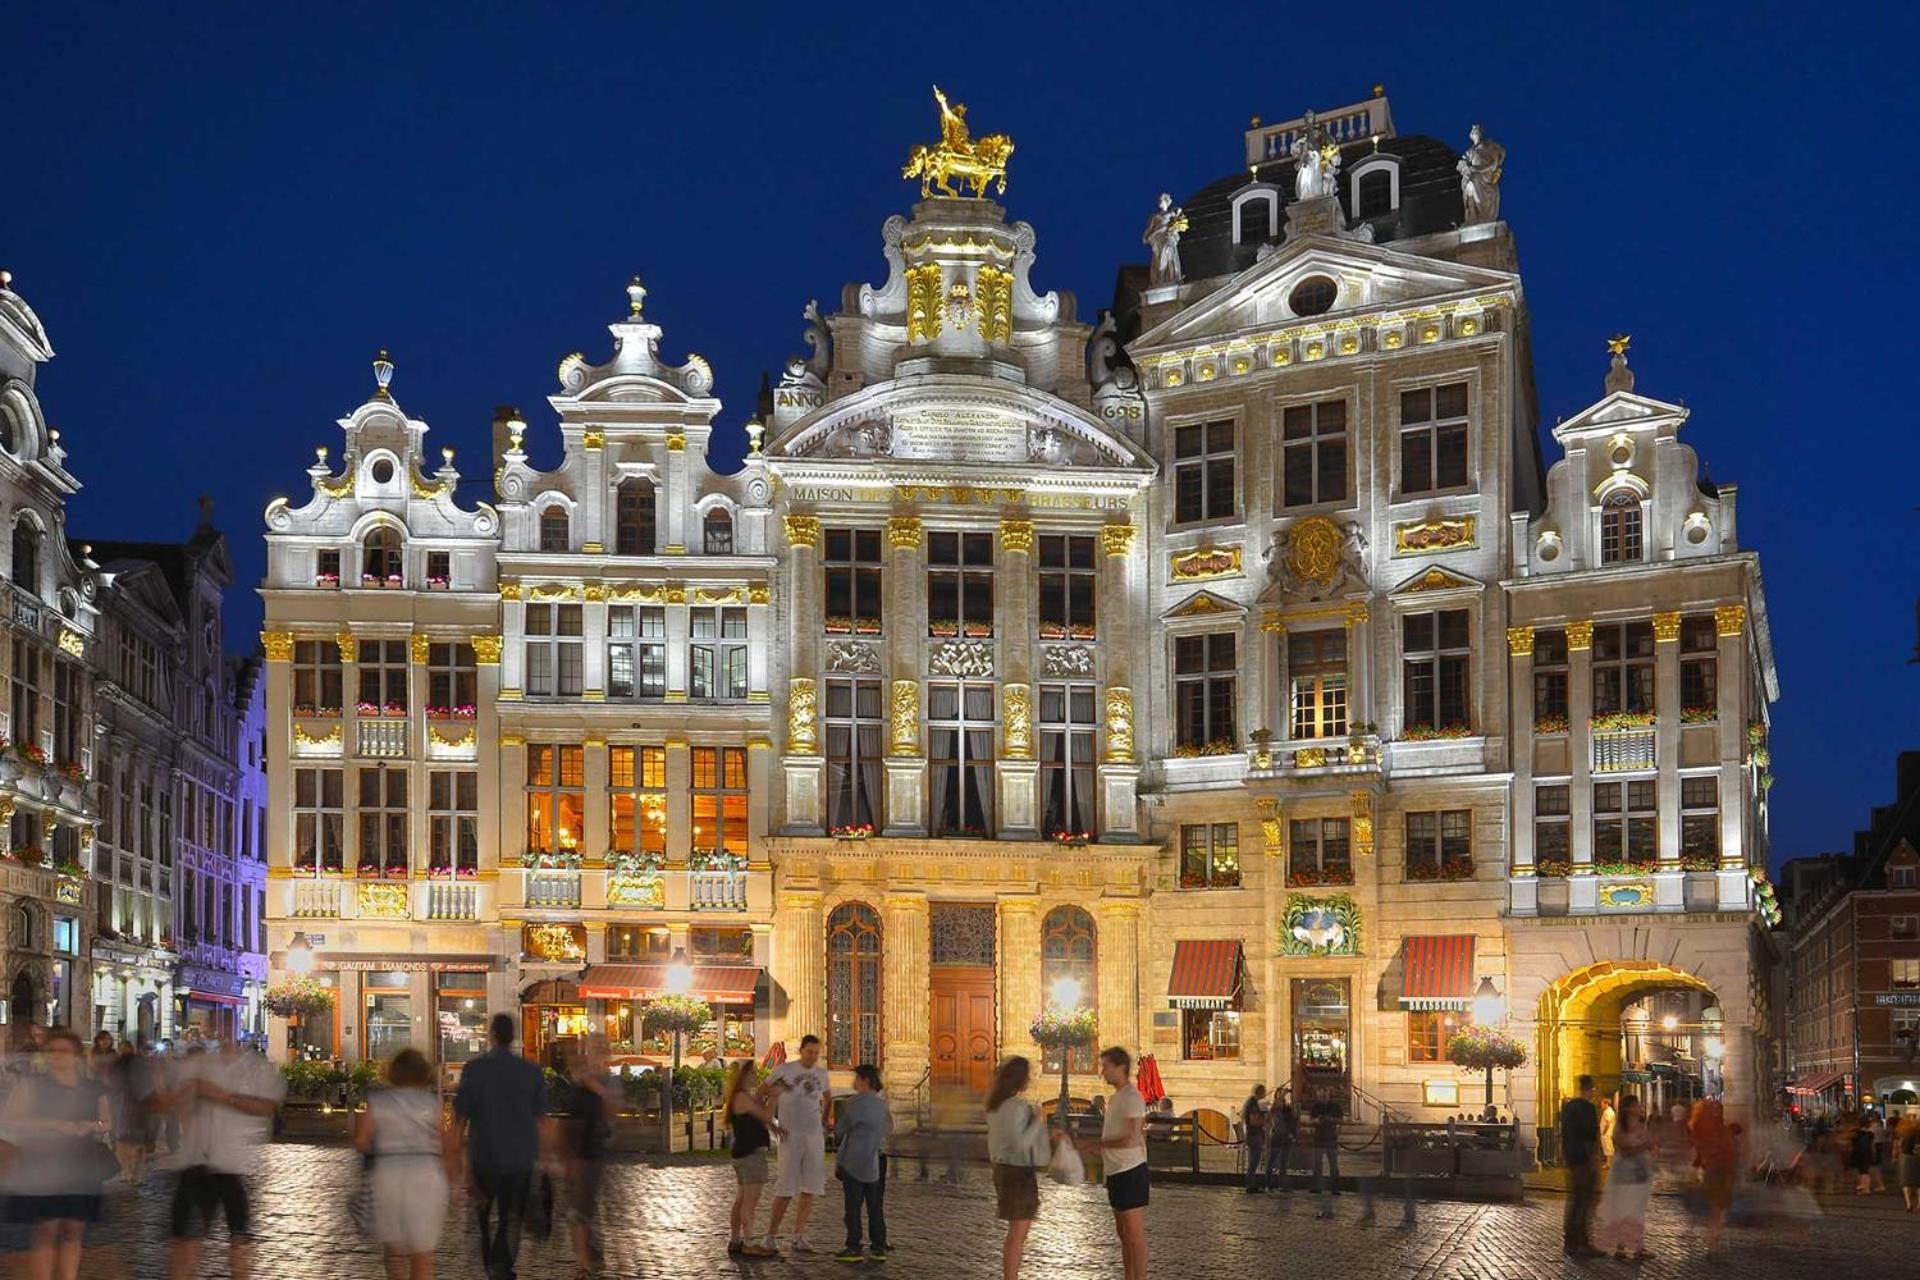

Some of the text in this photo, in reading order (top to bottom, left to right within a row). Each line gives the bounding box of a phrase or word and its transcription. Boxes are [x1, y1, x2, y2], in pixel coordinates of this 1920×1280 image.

[777, 391, 824, 408] ANNO
[794, 487, 853, 501] MAISON
[382, 961, 427, 972] DIAMONDS
[1176, 999, 1225, 1010] RESTAURANT
[1408, 1000, 1464, 1011] BRASSERIE
